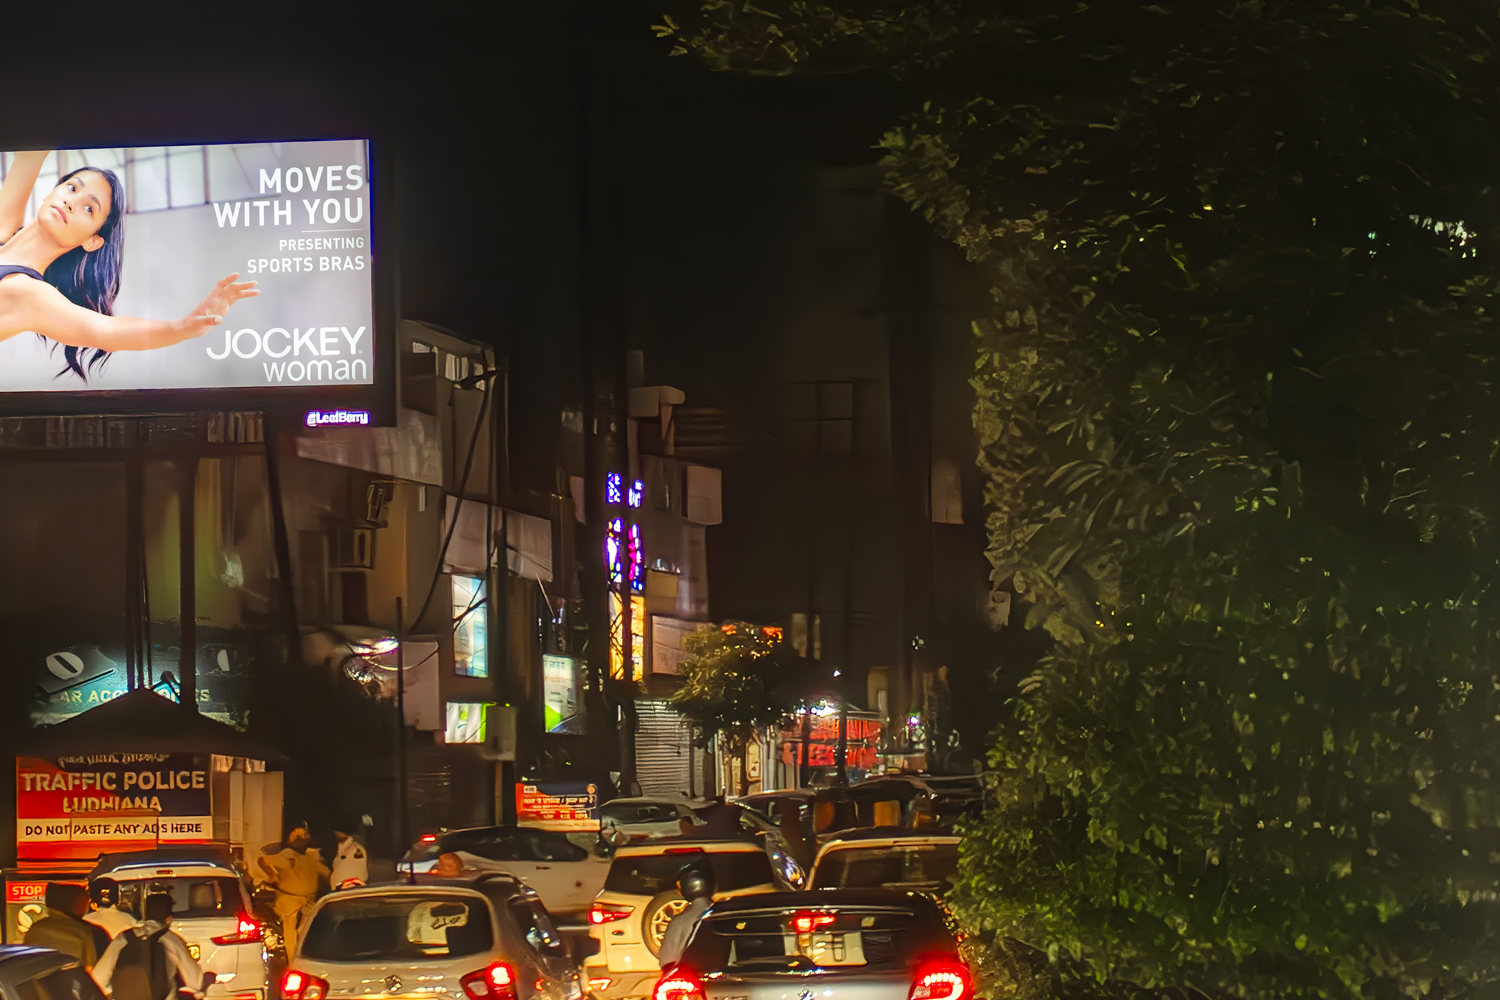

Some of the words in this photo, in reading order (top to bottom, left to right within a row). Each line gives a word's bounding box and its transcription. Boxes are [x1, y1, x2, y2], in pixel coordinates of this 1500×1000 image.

[259, 164, 363, 194] MOVES
[213, 199, 292, 228] WITH
[302, 197, 363, 225] YOU
[279, 236, 365, 251] PRESENTING
[247, 256, 313, 274] SPORTS
[319, 255, 365, 271] BRAS
[206, 326, 366, 360] JOCKEY
[263, 358, 367, 383] woman
[21, 771, 117, 792] TRAFFIC
[124, 770, 205, 791] POLICE
[62, 795, 163, 814] LUDHIANA
[25, 825, 43, 836] DO
[46, 825, 71, 836] NOT
[73, 824, 111, 835] PASTE
[114, 824, 140, 835] ANY
[170, 823, 203, 834] HERE
[12, 885, 43, 896] STOP
